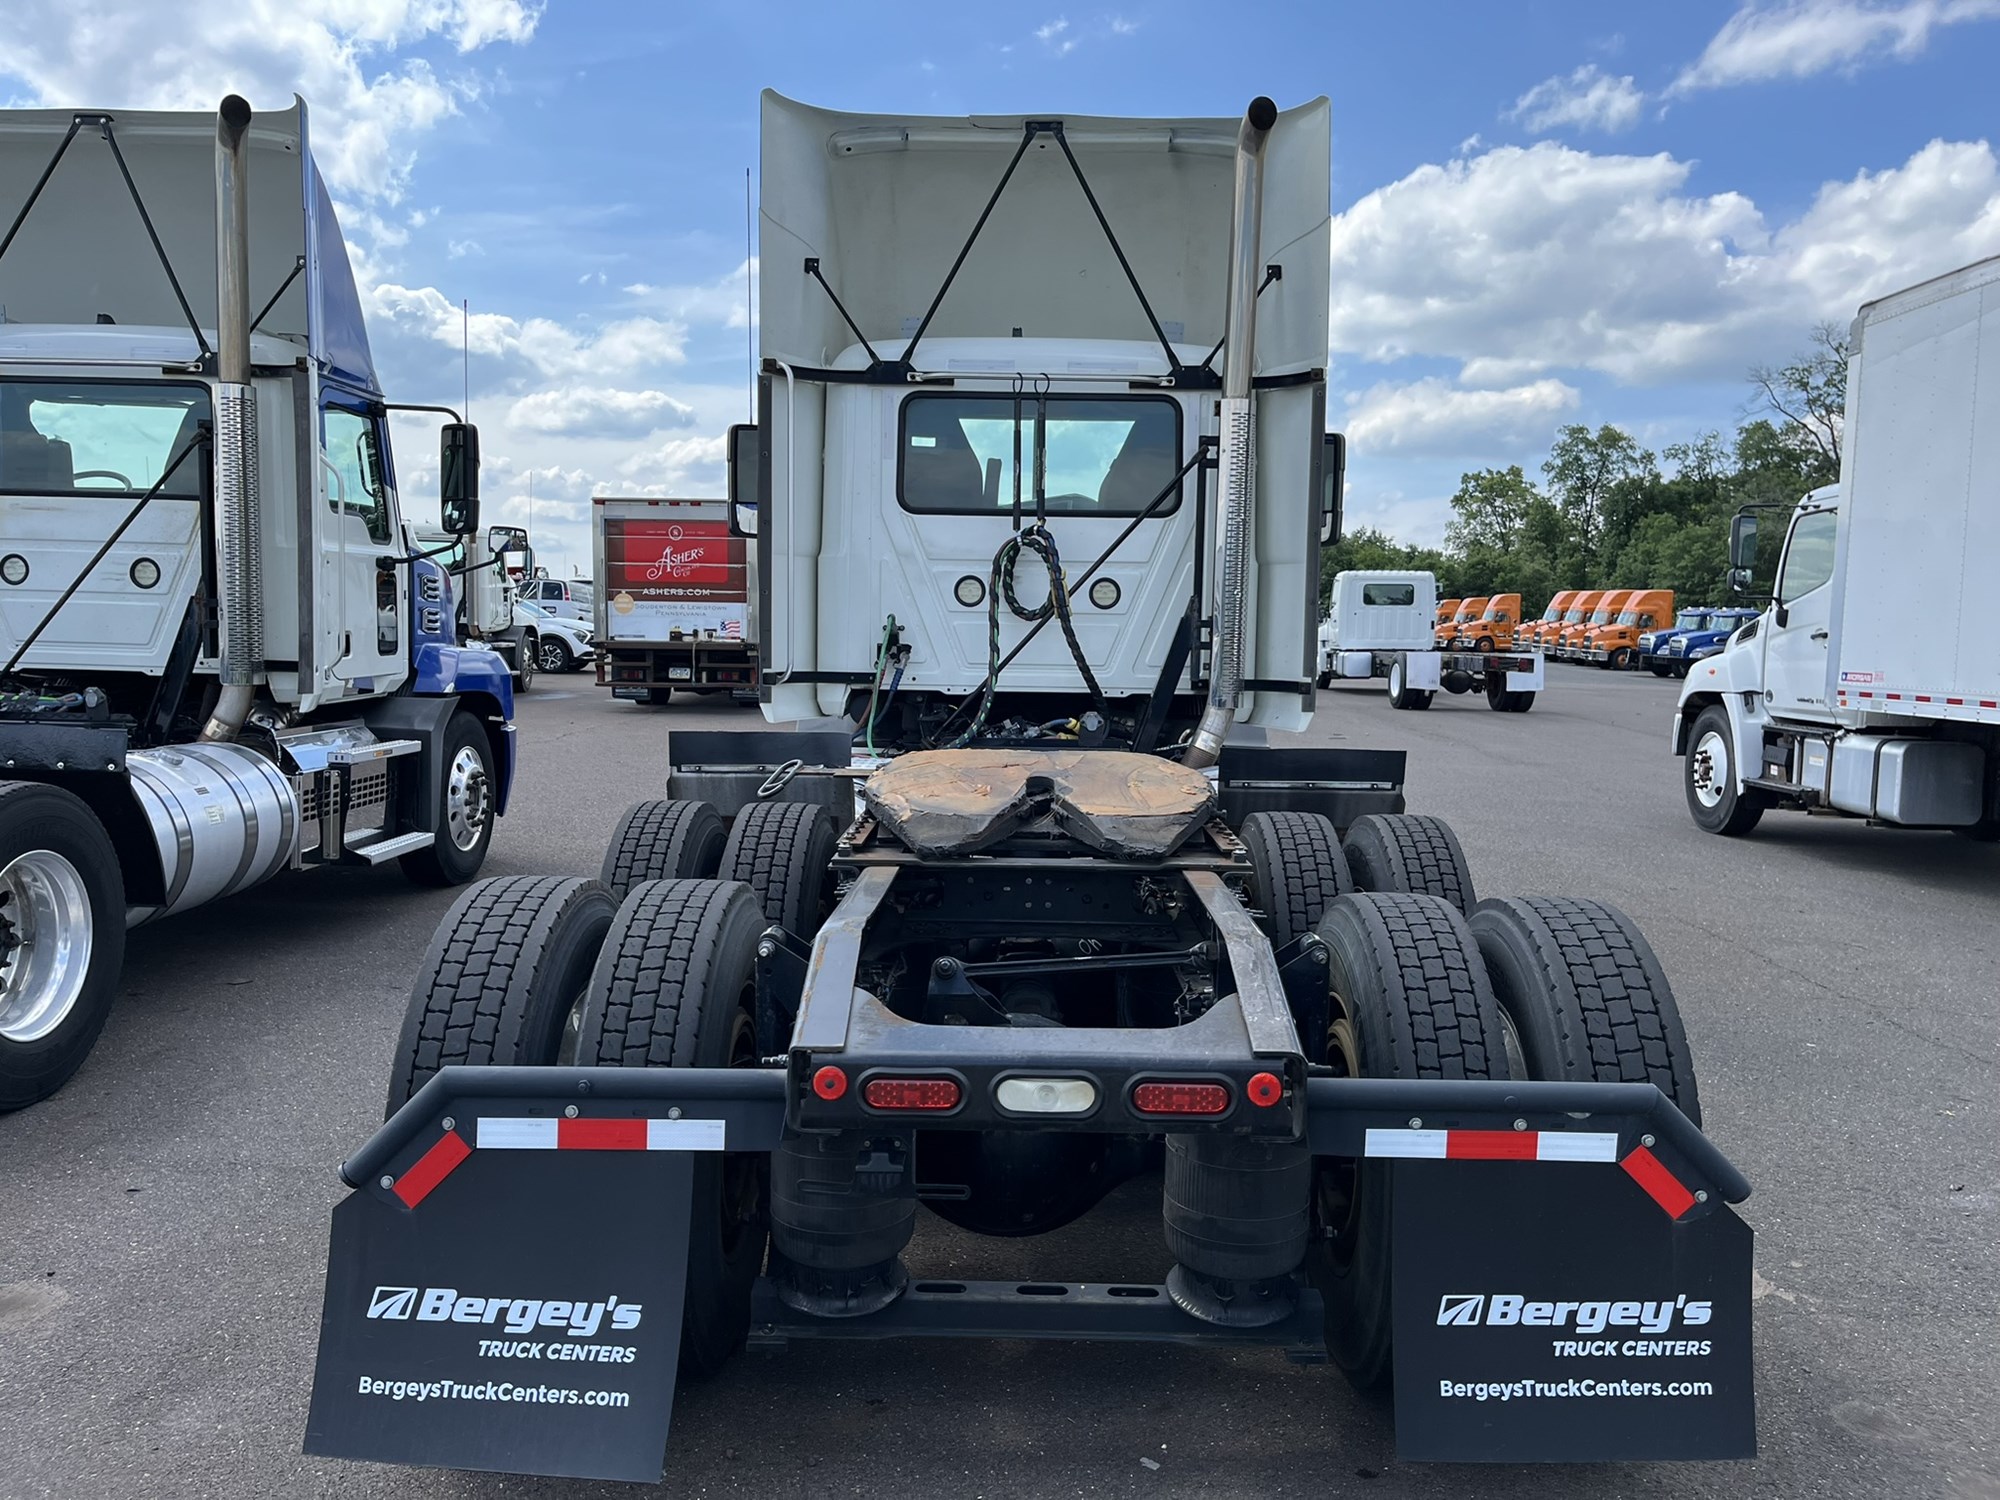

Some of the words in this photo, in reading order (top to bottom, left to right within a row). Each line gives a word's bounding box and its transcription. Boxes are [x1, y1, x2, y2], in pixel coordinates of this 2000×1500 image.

[642, 588, 711, 596] ASHERS.COM
[416, 1288, 643, 1337] Bergey's
[1486, 1293, 1713, 1334] Bergey's
[478, 1340, 545, 1360] TRUCK
[547, 1342, 638, 1364] CENTERS
[1552, 1340, 1618, 1357] TRUCK
[1621, 1340, 1712, 1357] CENTERS
[358, 1376, 630, 1408] BergeysTruckCenters.com
[1440, 1379, 1713, 1402] BergeysTruckCenters.com
